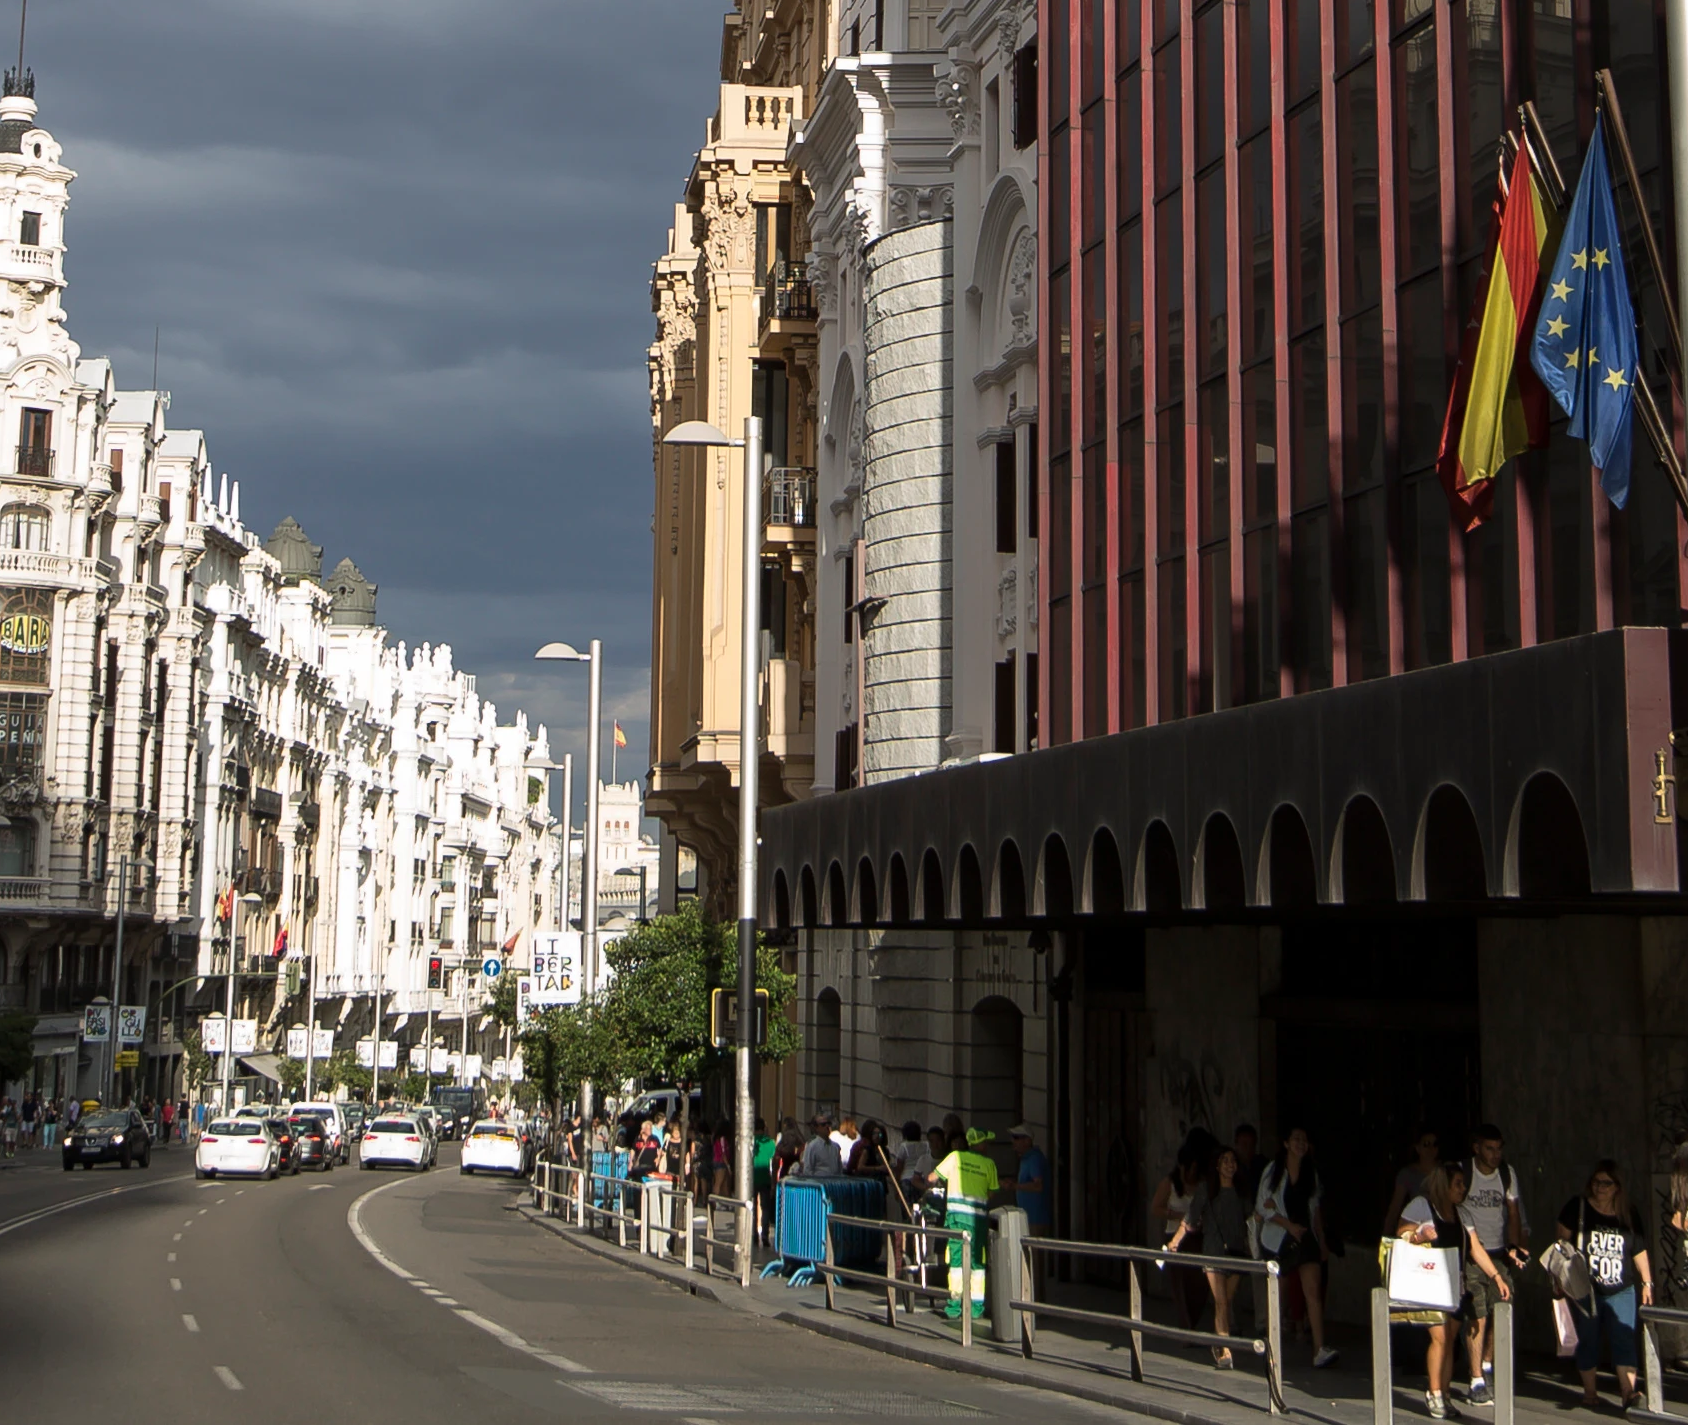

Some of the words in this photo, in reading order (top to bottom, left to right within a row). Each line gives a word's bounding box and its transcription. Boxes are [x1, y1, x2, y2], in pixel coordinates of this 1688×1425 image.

[534, 938, 559, 955] LI
[1591, 1230, 1624, 1253] EVER
[1589, 1254, 1623, 1280] FOR
